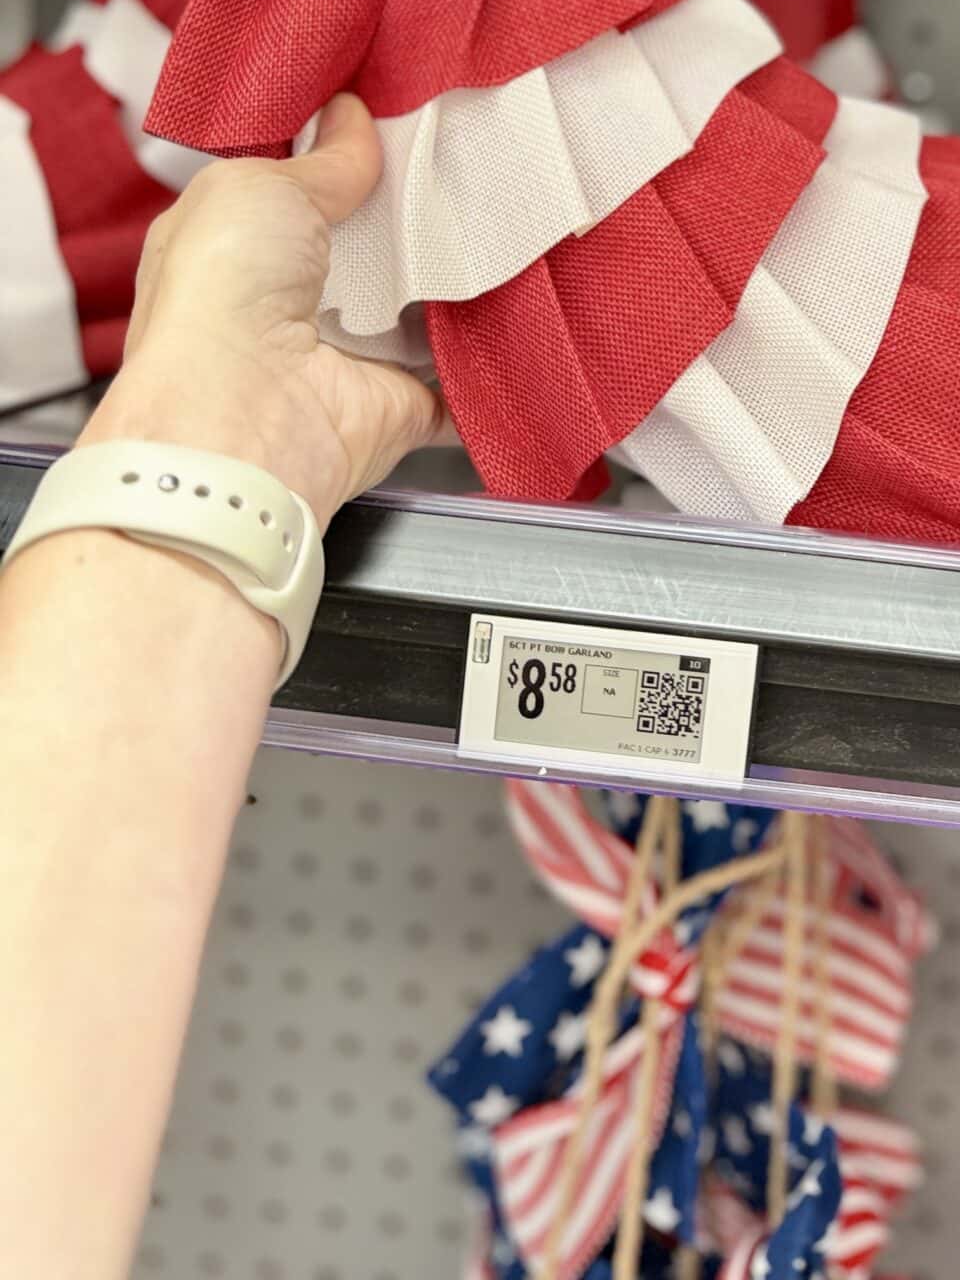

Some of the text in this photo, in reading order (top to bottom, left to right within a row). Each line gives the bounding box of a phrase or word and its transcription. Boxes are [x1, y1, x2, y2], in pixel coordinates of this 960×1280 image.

[530, 643, 541, 652] PT
[545, 644, 565, 655] BOW
[568, 647, 613, 660] GARLAND
[672, 748, 697, 759] 3777
